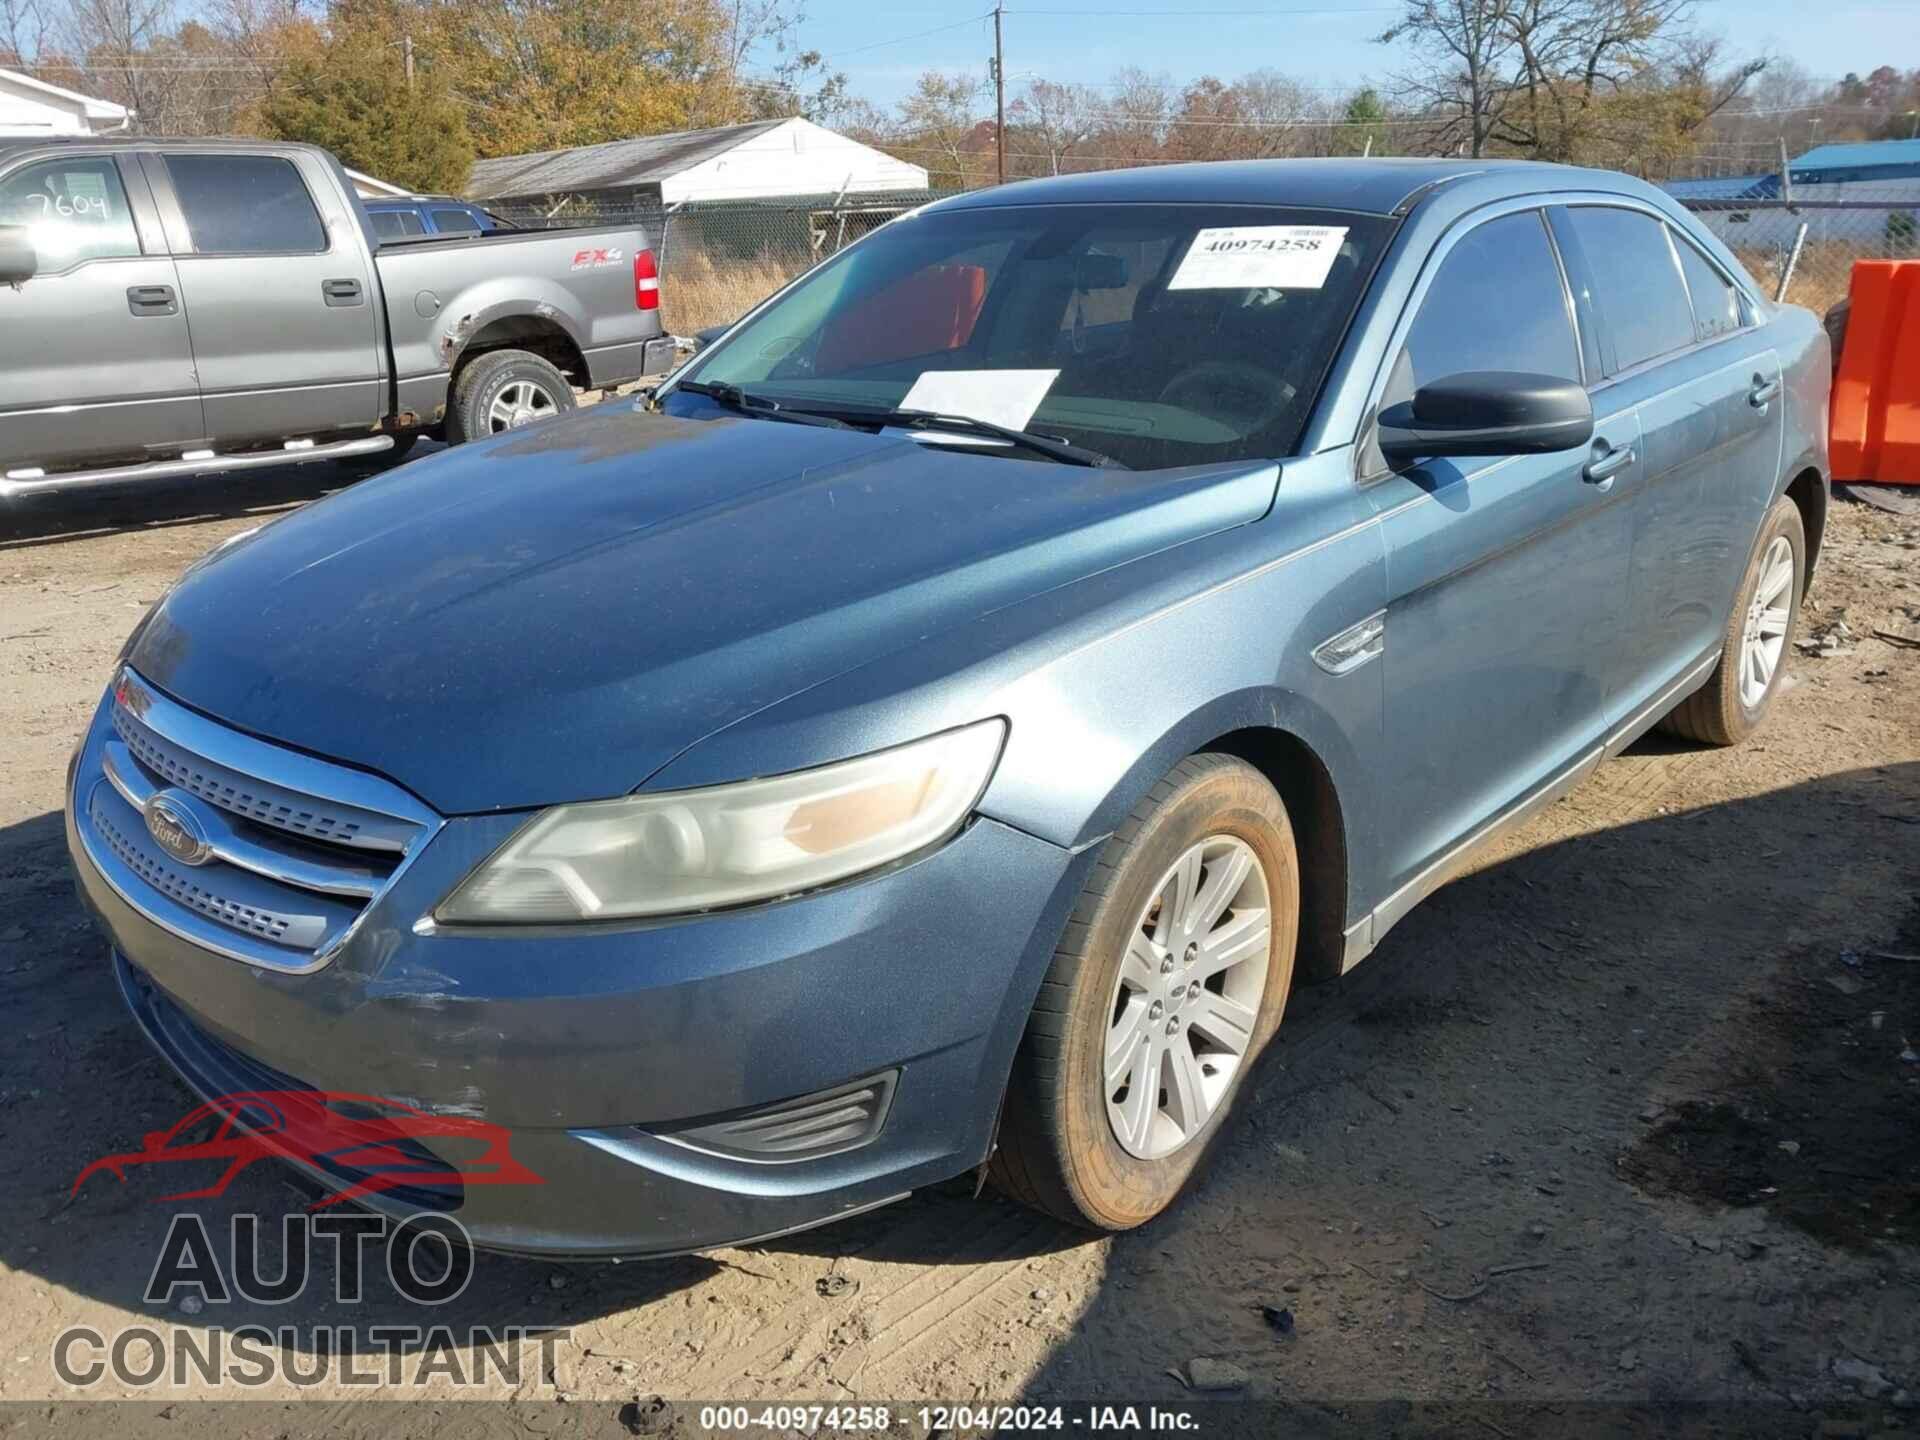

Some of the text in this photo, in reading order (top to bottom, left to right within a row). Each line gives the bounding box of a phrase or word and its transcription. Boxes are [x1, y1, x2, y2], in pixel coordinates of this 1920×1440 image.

[25, 193, 109, 219] 7604
[572, 248, 623, 264] FX4
[1204, 239, 1322, 252] 40974258
[151, 809, 183, 849] Ford
